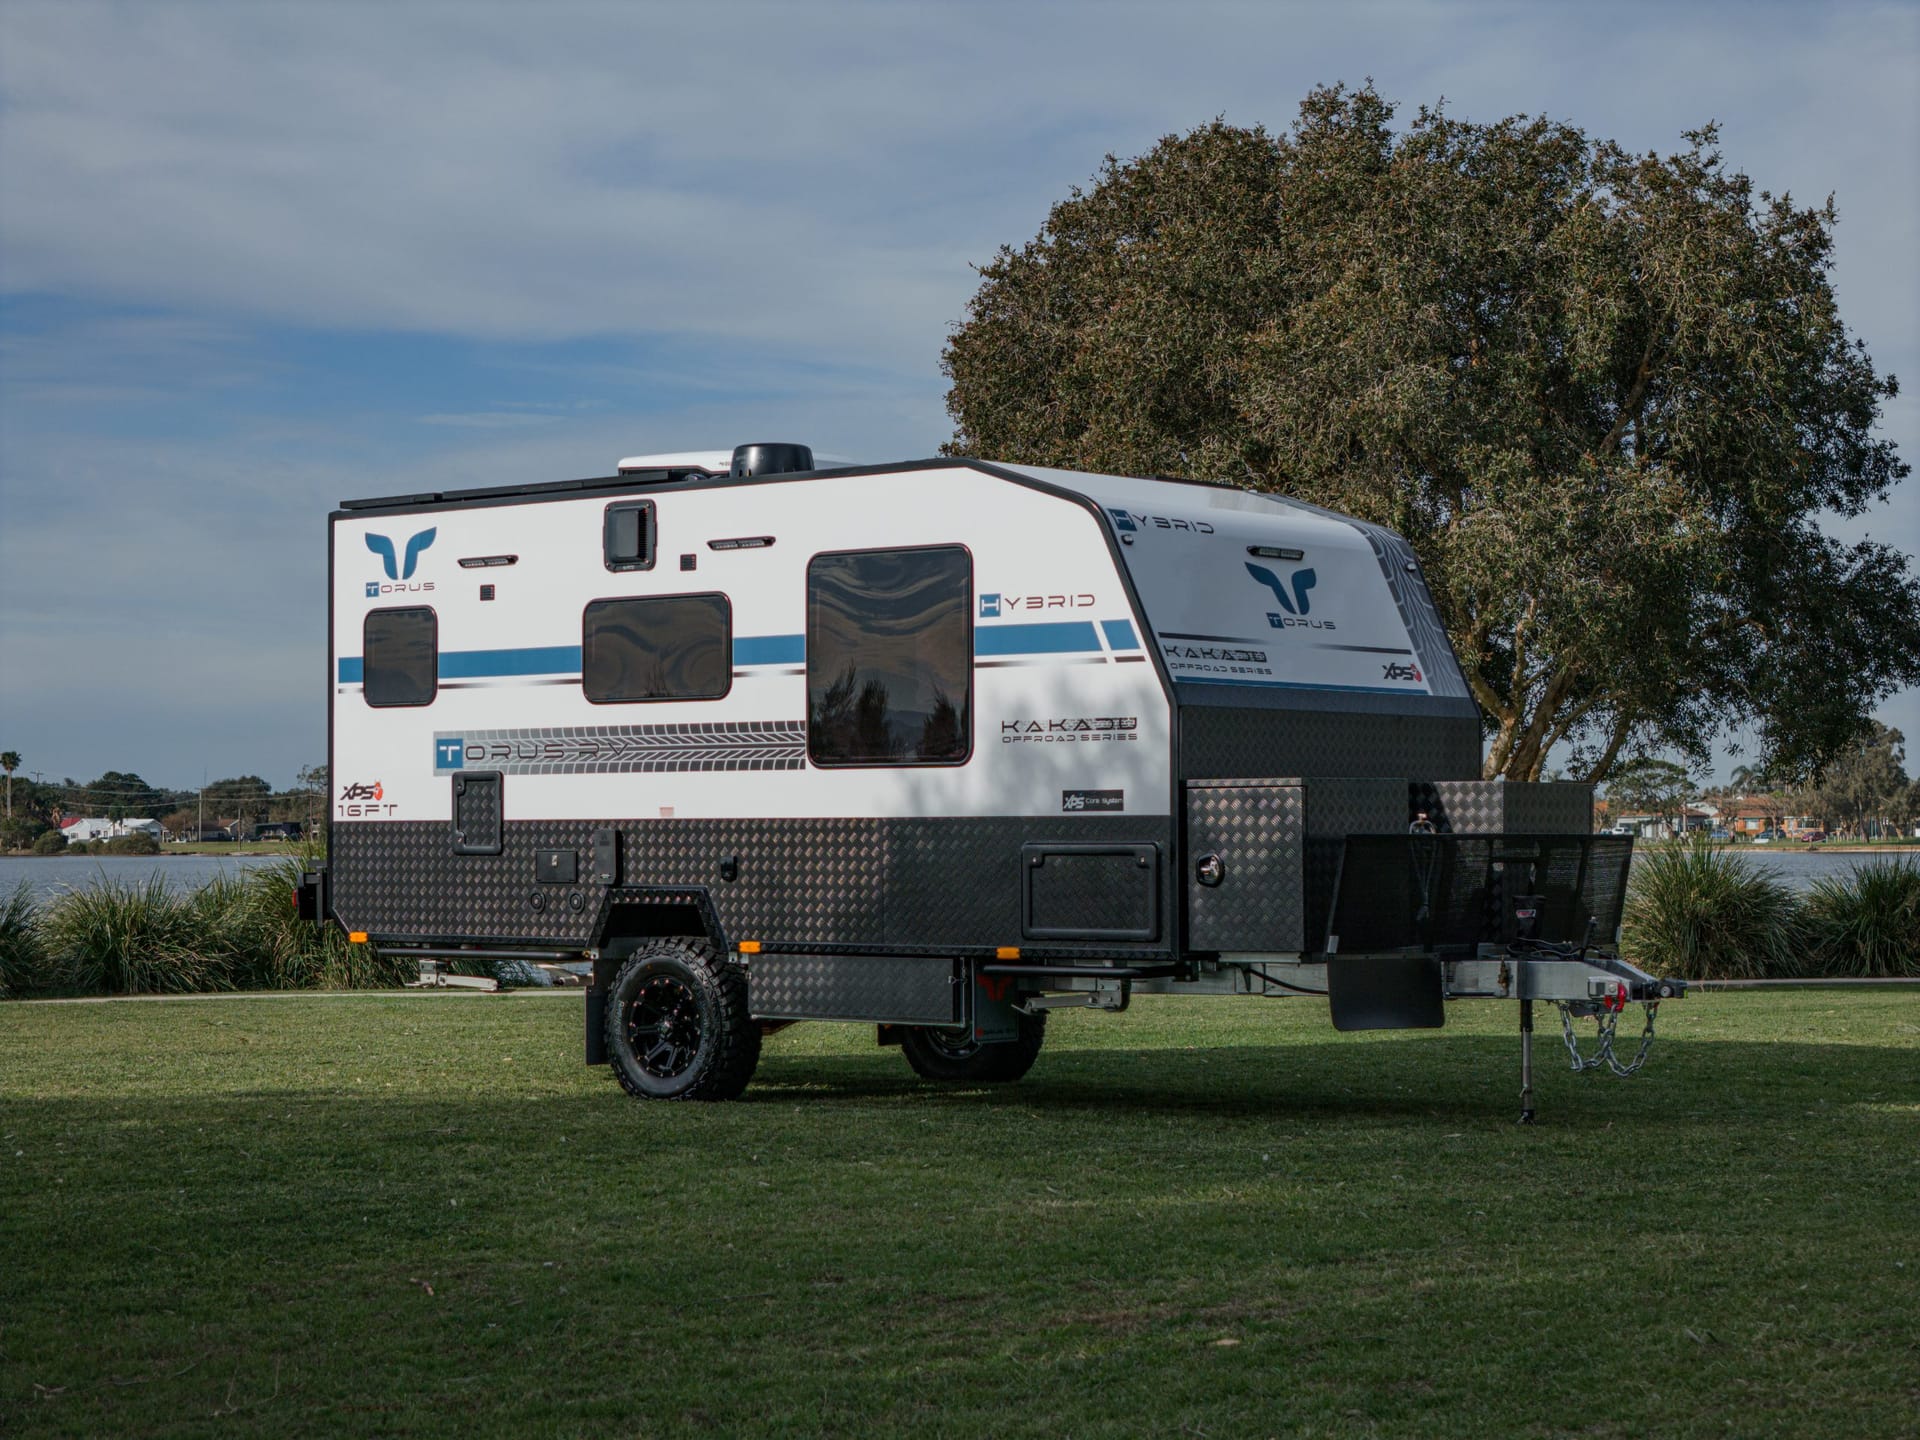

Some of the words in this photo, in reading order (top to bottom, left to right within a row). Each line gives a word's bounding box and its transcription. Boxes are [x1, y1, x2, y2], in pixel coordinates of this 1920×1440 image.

[1108, 509, 1214, 534] HYBRID
[366, 582, 435, 597] TORUS
[980, 593, 1095, 617] HYBRID
[1266, 612, 1336, 630] TORUS
[1170, 662, 1227, 672] OFFROAD
[1230, 666, 1272, 675] SERIES
[1382, 662, 1414, 680] XPS
[1002, 734, 1076, 743] OFFROAD
[1080, 733, 1137, 741] SERIES
[340, 782, 375, 800] XPS
[1064, 794, 1085, 809] XPS
[338, 804, 398, 816] 16FT
